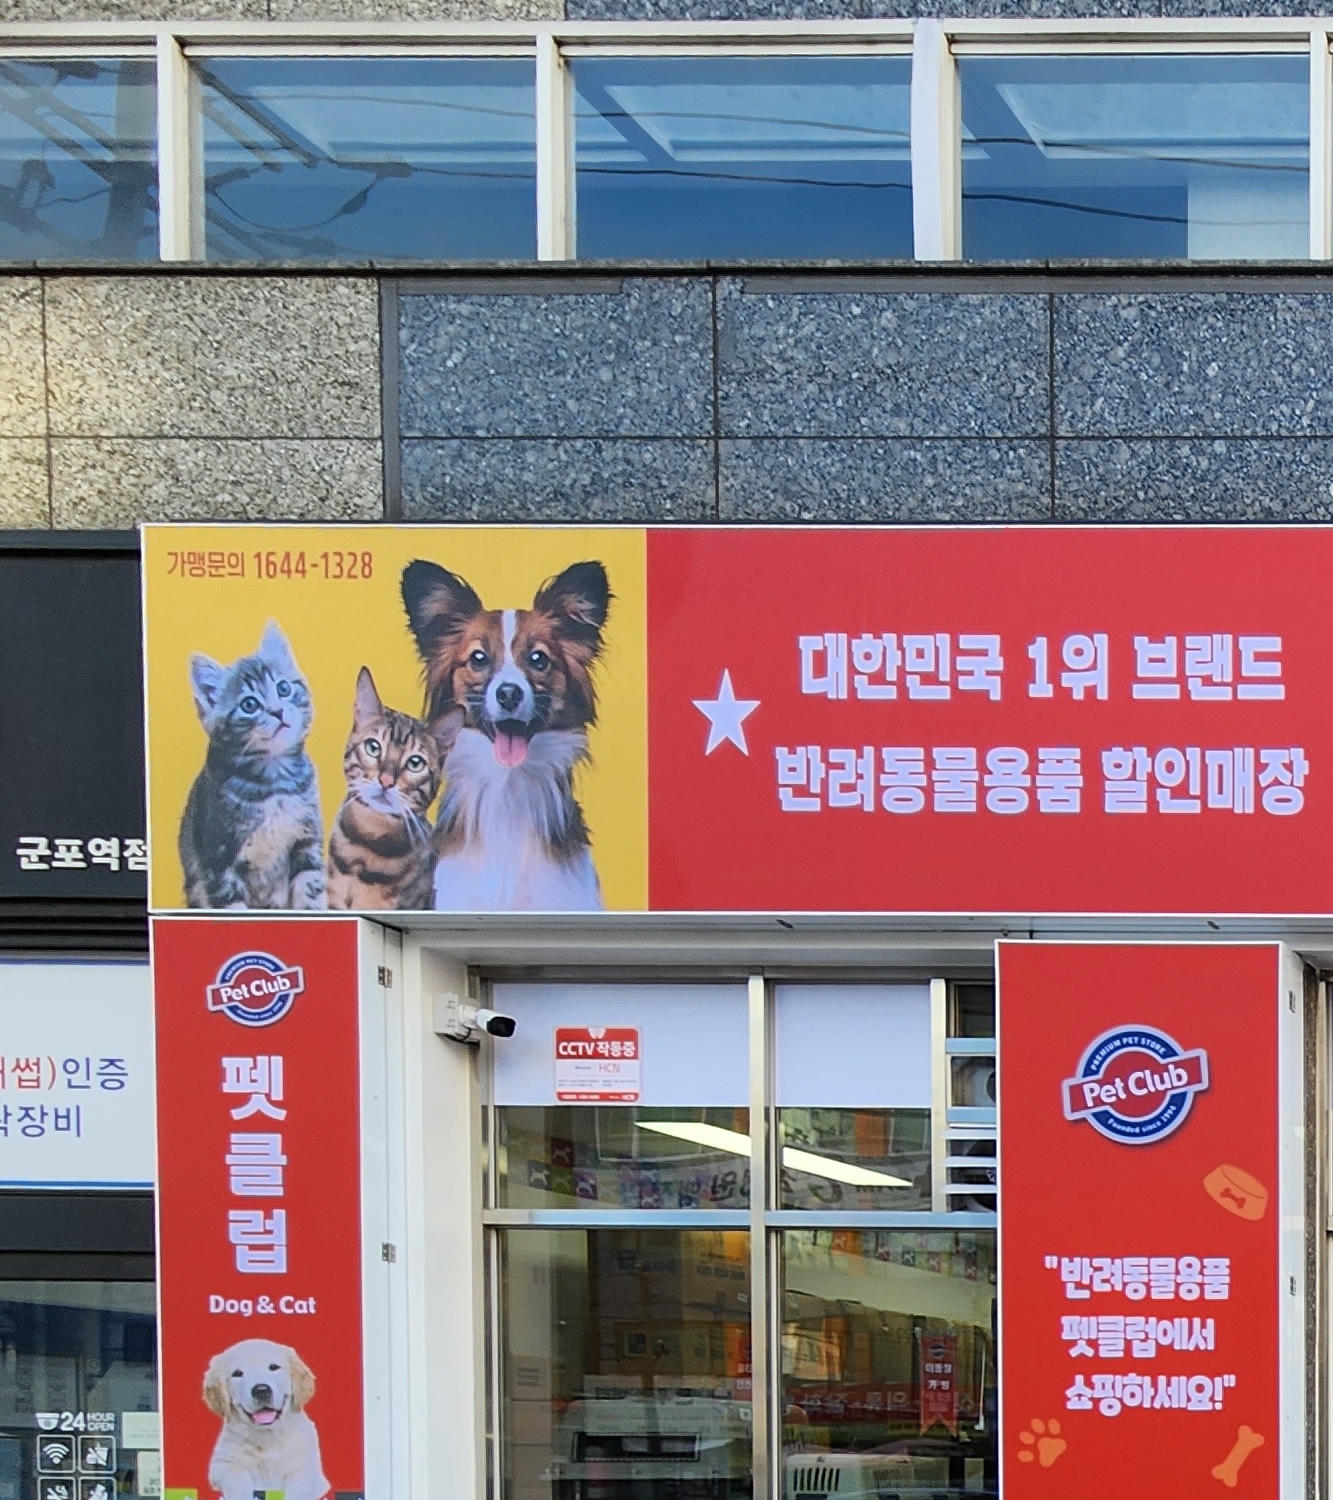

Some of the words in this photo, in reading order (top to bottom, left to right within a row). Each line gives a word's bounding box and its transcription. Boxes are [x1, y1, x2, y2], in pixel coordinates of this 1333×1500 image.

[167, 550, 245, 579] 가맹문의
[253, 552, 374, 579] 1644-1328
[799, 633, 1003, 701] 대한민국
[1027, 633, 1110, 701] 1위
[1131, 633, 1286, 701] 브랜드
[774, 744, 1084, 814] 반려동물용품
[1101, 747, 1309, 815] 할인매장
[16, 836, 148, 871] 군포역점
[220, 983, 250, 1004] Pet
[250, 976, 291, 997] Club
[558, 1042, 595, 1056] CCTV
[596, 1041, 636, 1058] 작동중
[1122, 1037, 1139, 1045] PET
[1140, 1037, 1167, 1055] STORE
[0, 1056, 129, 1091] 썹)인증
[599, 1063, 621, 1074] HCN
[1082, 1077, 1127, 1108] Pet
[1127, 1064, 1188, 1097] Club
[1043, 1254, 1231, 1300] "반려동물용품
[209, 1294, 253, 1317] Dog
[256, 1295, 276, 1315] &
[279, 1294, 317, 1315] Cat
[1060, 1315, 1216, 1358] 펫클럽에서
[1064, 1373, 1236, 1418] 쇼핑하세요!"
[60, 1412, 86, 1432] 24
[87, 1412, 115, 1422] HOUR
[87, 1422, 115, 1432] OPEN
